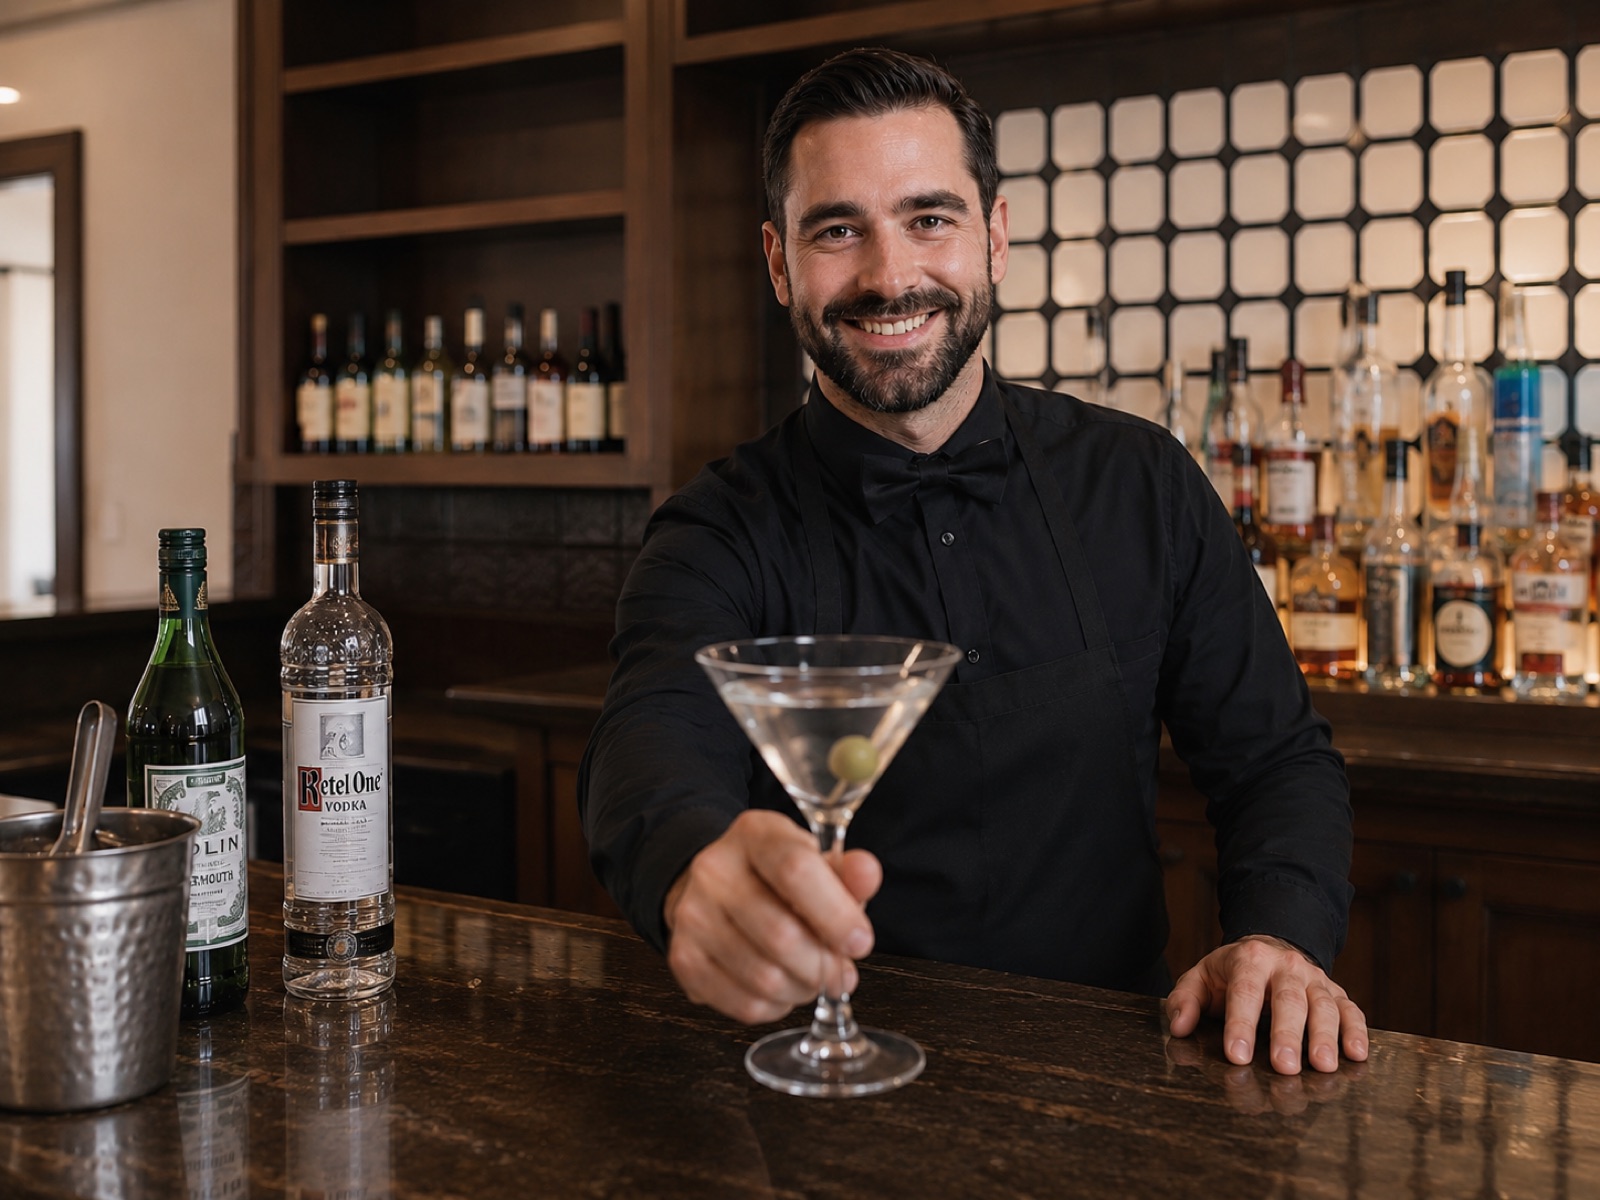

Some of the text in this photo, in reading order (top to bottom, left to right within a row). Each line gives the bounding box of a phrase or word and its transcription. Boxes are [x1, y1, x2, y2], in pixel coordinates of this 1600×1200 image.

[353, 770, 381, 794] One
[325, 799, 367, 812] VODKA
[192, 834, 239, 856] OLIN
